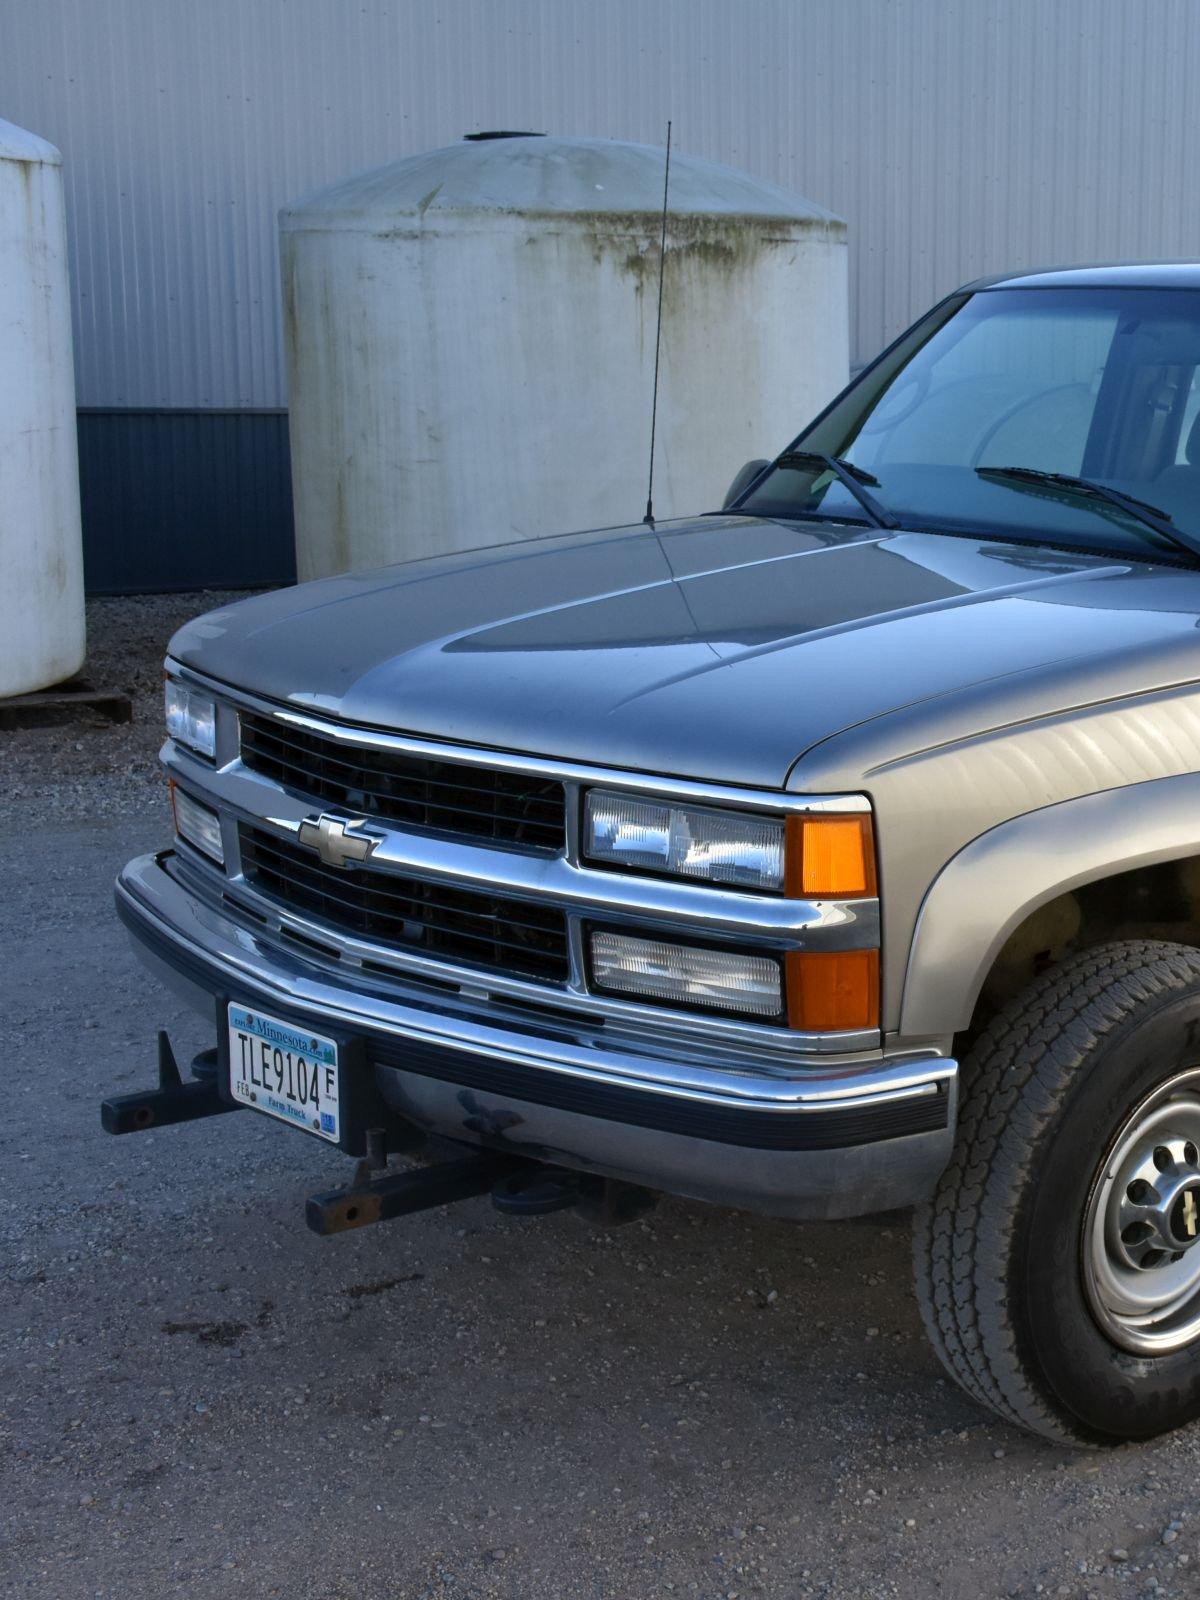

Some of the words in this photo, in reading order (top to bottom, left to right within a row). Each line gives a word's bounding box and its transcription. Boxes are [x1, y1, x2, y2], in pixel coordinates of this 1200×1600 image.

[238, 1033, 320, 1112] TLE9104
[325, 1067, 335, 1094] F
[237, 1081, 250, 1097] FEB
[268, 1097, 286, 1111] Farm
[287, 1103, 306, 1120] Truck
